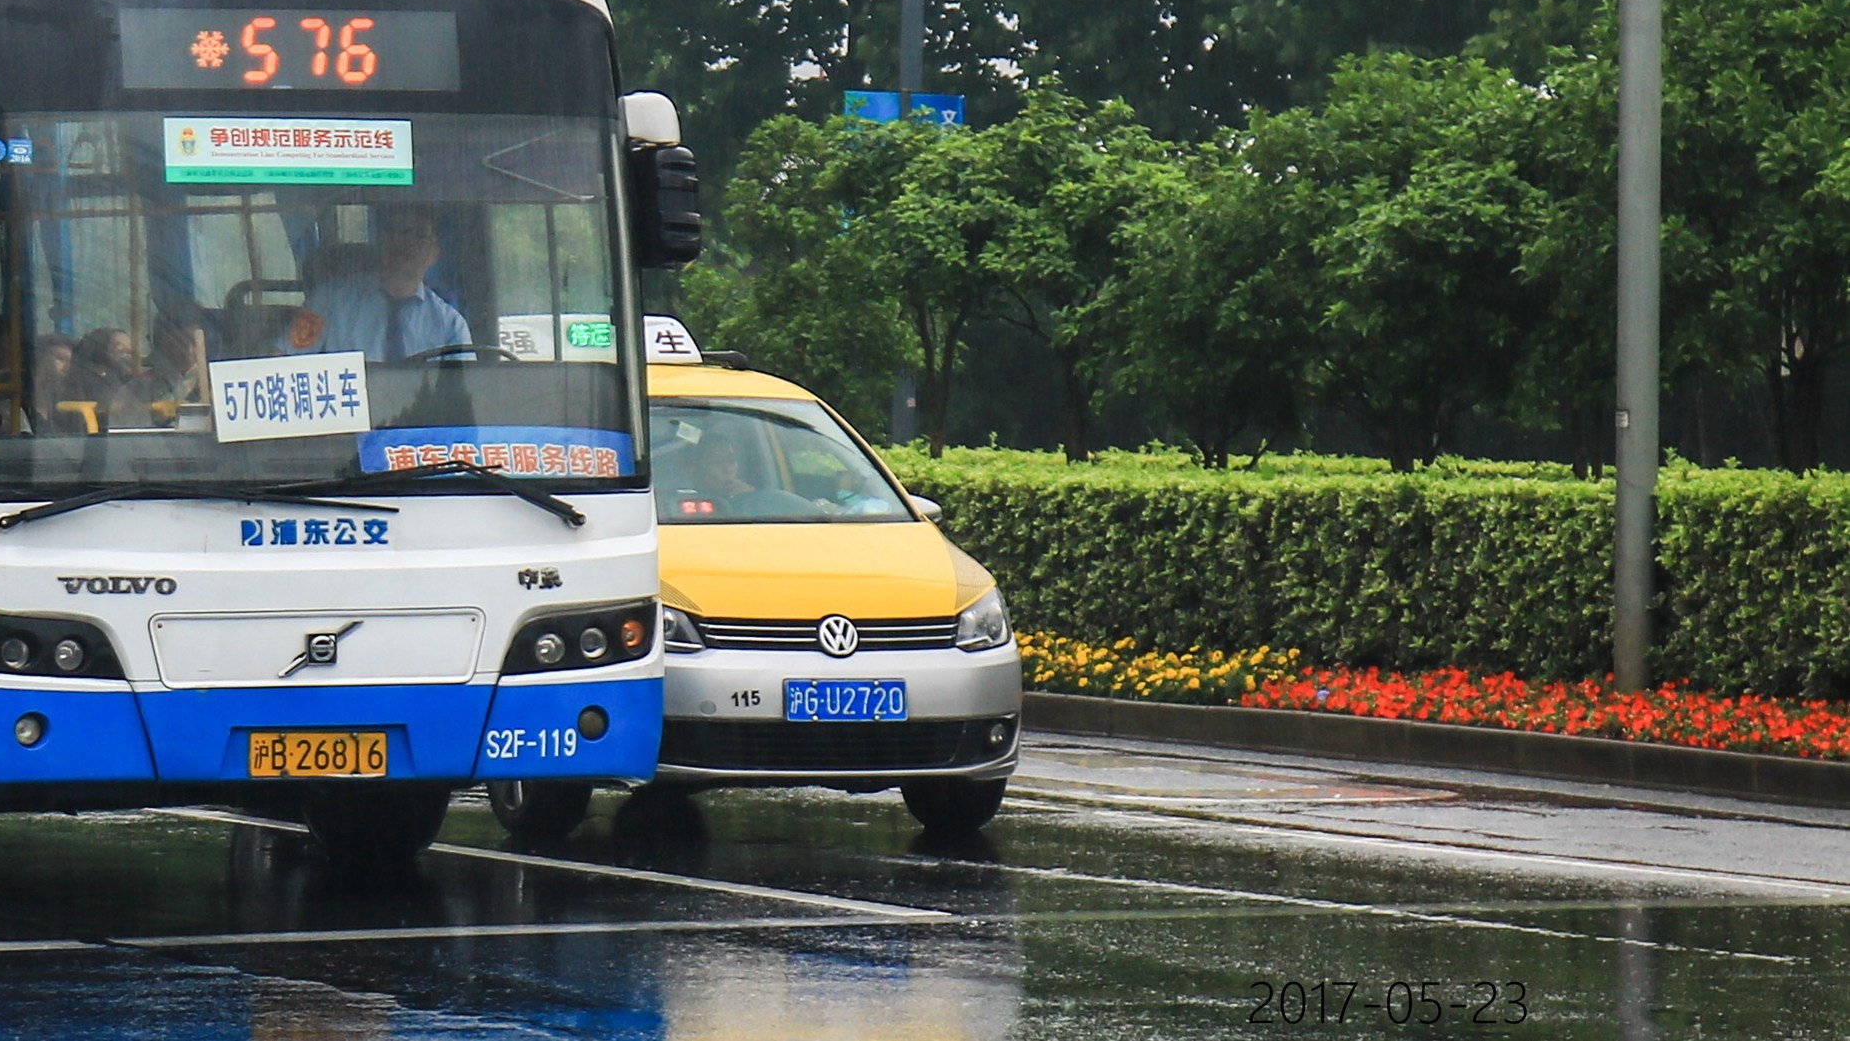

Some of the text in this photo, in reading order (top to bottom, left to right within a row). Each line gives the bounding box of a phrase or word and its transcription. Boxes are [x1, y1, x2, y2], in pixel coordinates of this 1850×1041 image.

[240, 16, 378, 84] 576
[210, 127, 394, 149] 争创规范服务示范线
[500, 330, 691, 354] 强 生
[570, 323, 611, 347] 待运
[224, 368, 360, 422] 576路调头车
[385, 444, 619, 477] 浦东优质服务线路
[270, 518, 389, 546] 浦东公交
[57, 576, 177, 595] VOLVO
[731, 690, 761, 708] 115
[487, 728, 577, 760] S2F-119
